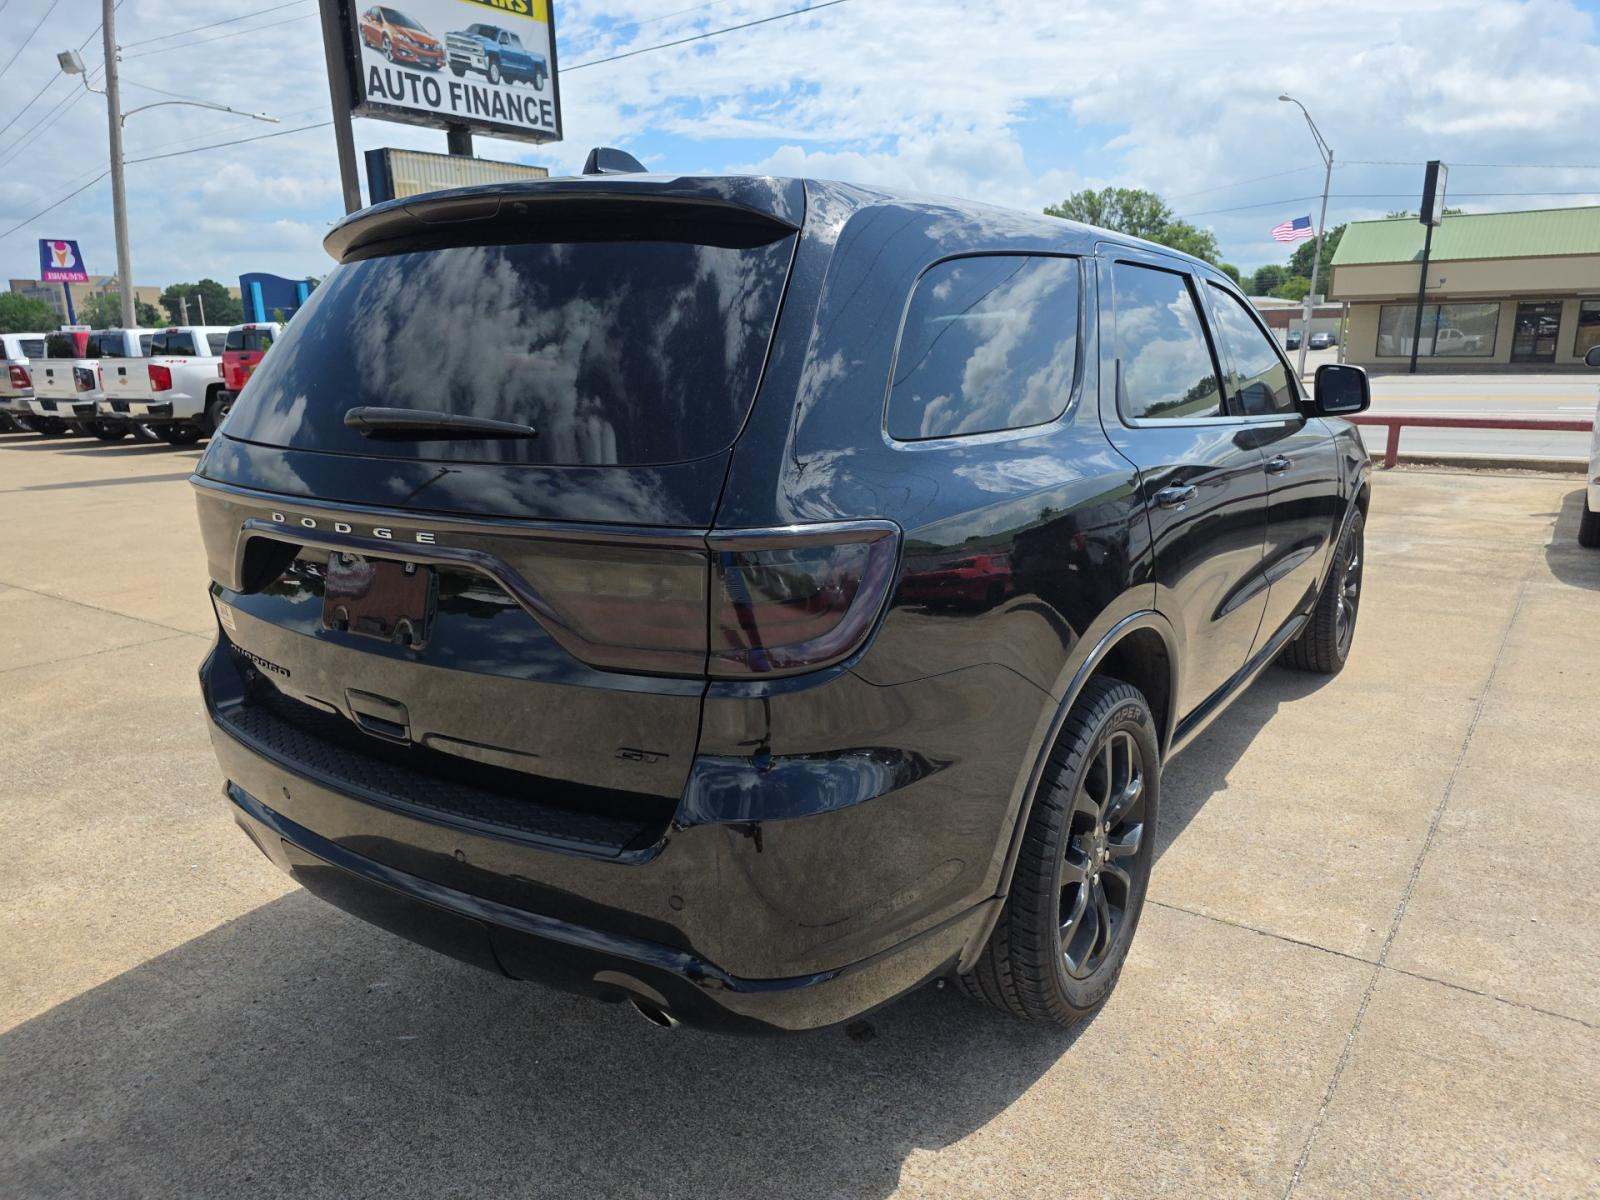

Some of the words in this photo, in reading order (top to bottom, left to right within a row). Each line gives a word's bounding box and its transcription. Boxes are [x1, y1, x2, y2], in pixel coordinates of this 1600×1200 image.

[367, 65, 442, 108] AUTO
[448, 81, 554, 128] FINANCE
[271, 511, 437, 545] DODGE
